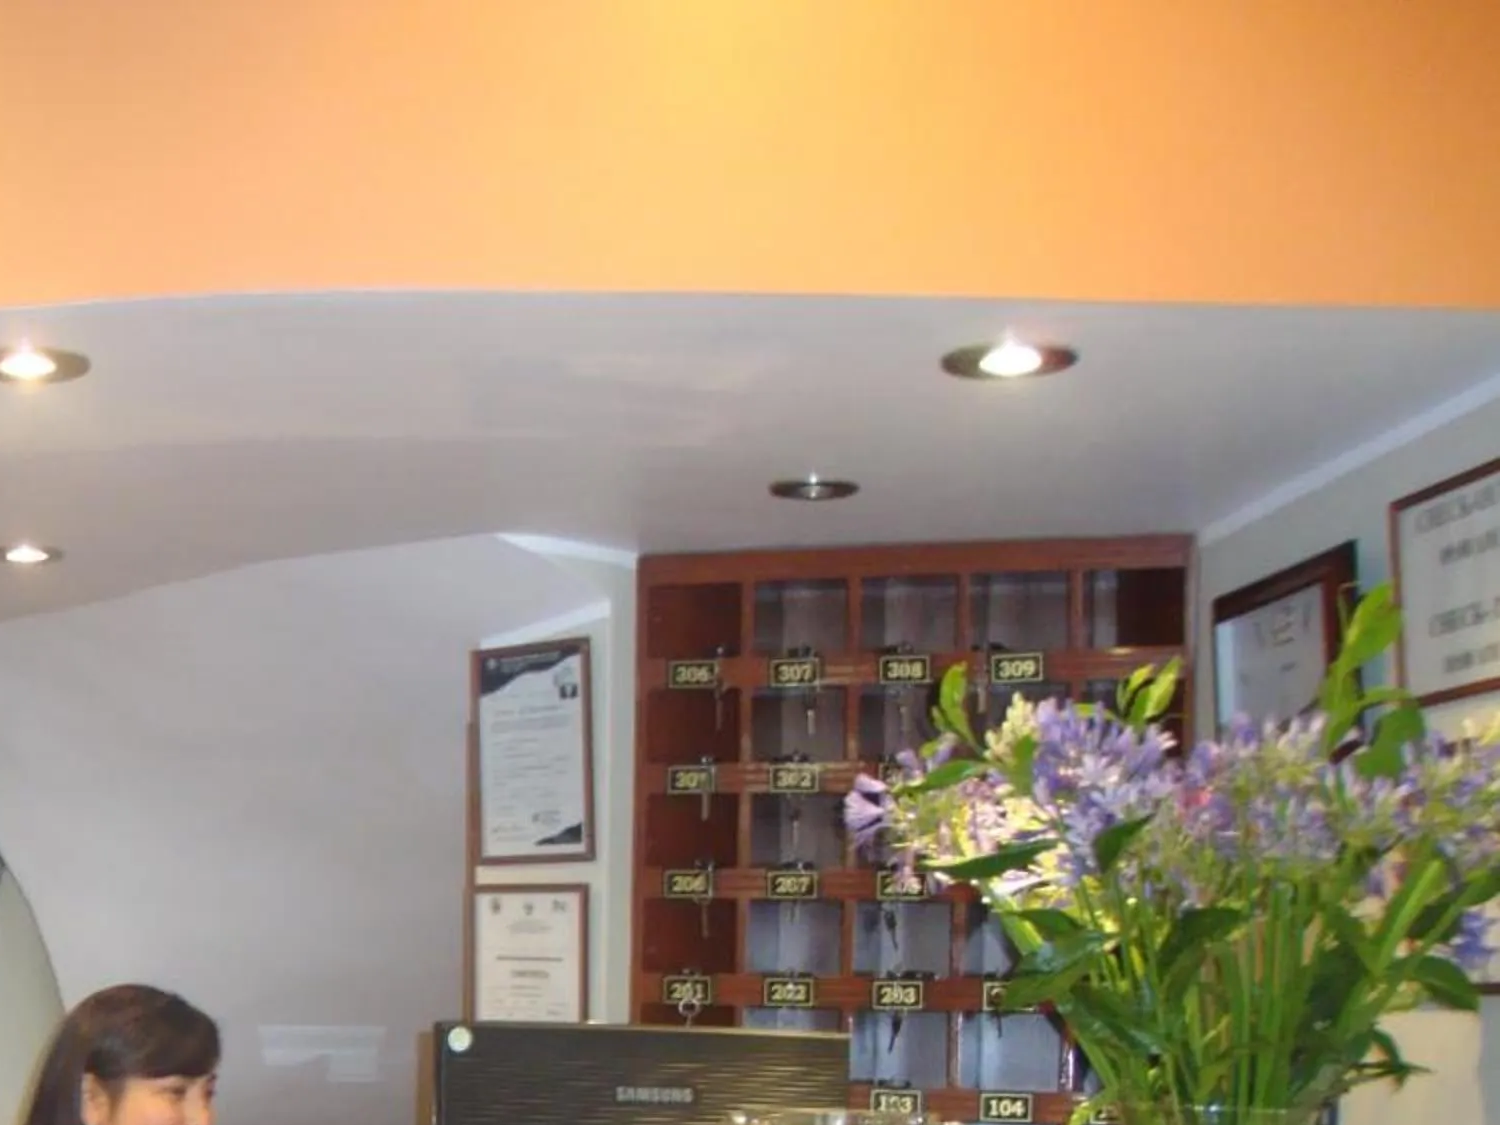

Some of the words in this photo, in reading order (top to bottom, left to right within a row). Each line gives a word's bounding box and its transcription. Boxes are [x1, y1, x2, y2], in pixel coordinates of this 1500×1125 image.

[674, 665, 710, 683] 306
[777, 663, 813, 682] 307
[887, 661, 924, 678] 308
[998, 659, 1036, 678] 309
[775, 876, 811, 894] 207
[880, 986, 916, 1004] 203
[615, 1086, 693, 1103] SAMSUNG
[988, 1099, 1025, 1117] 104
